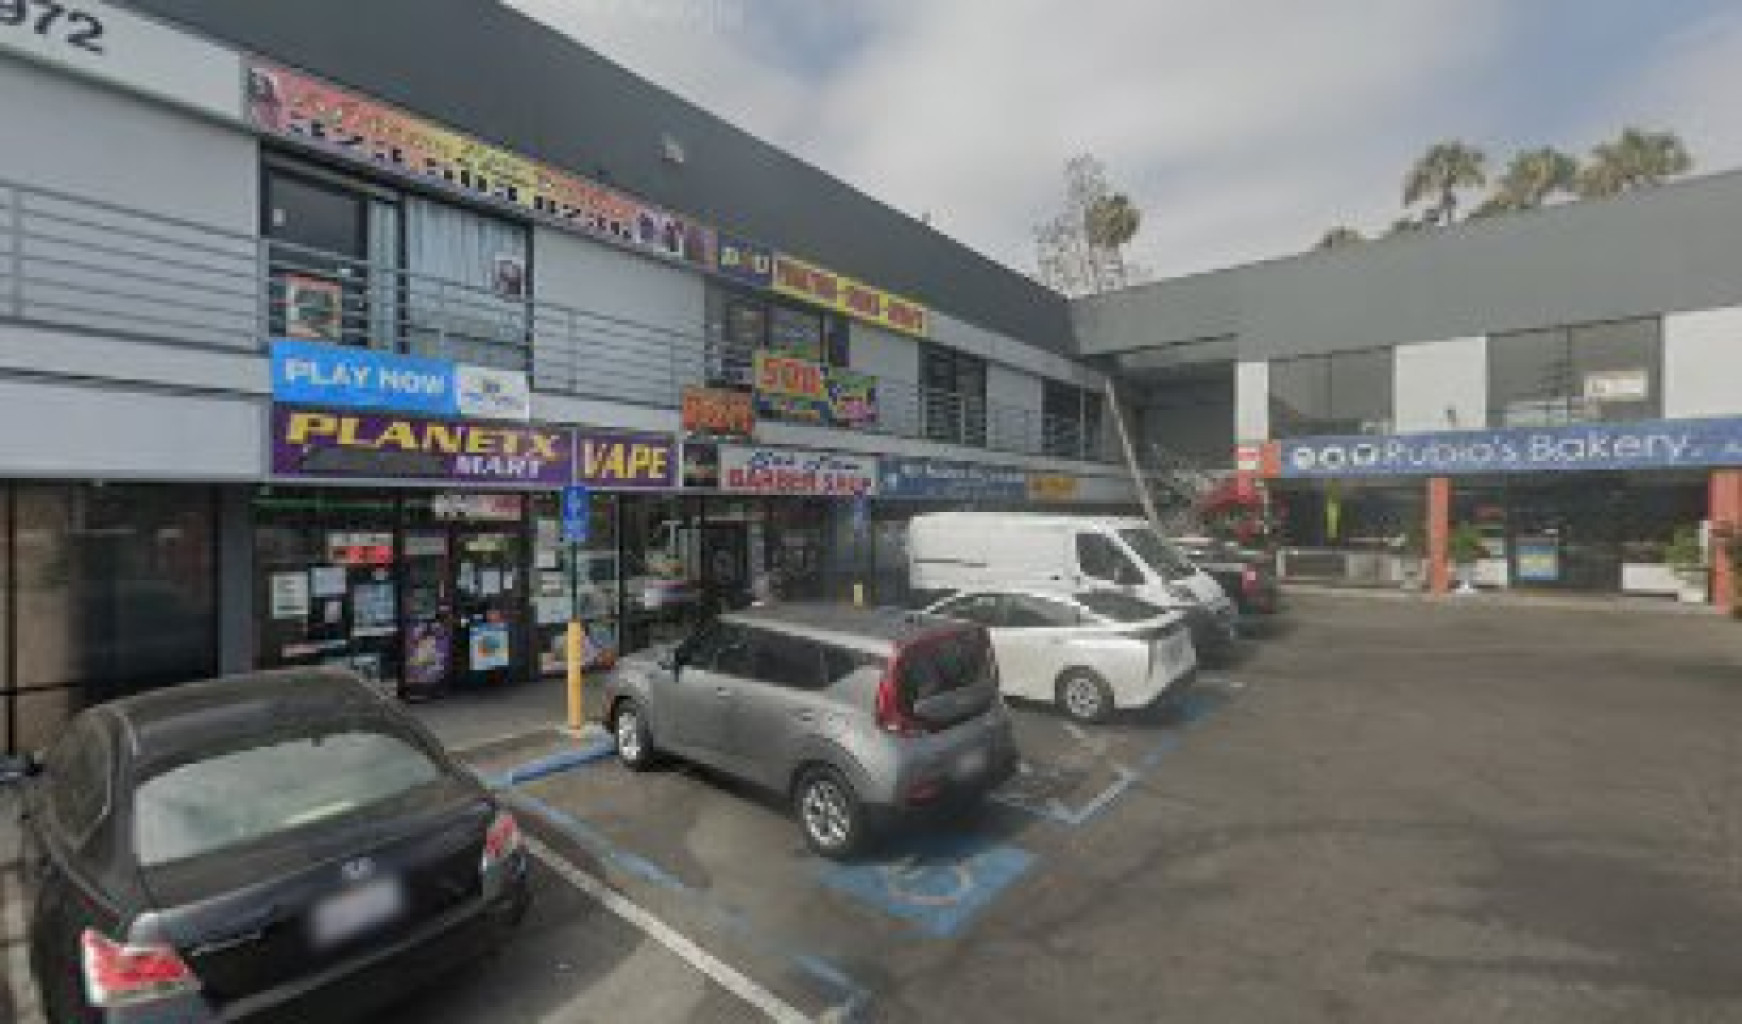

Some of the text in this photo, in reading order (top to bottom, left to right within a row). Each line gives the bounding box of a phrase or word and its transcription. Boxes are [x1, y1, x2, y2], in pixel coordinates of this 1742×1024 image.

[284, 358, 371, 386] PLAY
[378, 367, 445, 394] NOW
[583, 440, 667, 479] VAPE
[1386, 434, 1517, 467] Rubio's
[1528, 430, 1688, 467] Bakery
[456, 455, 542, 479] MART
[729, 468, 817, 489] BARBER
